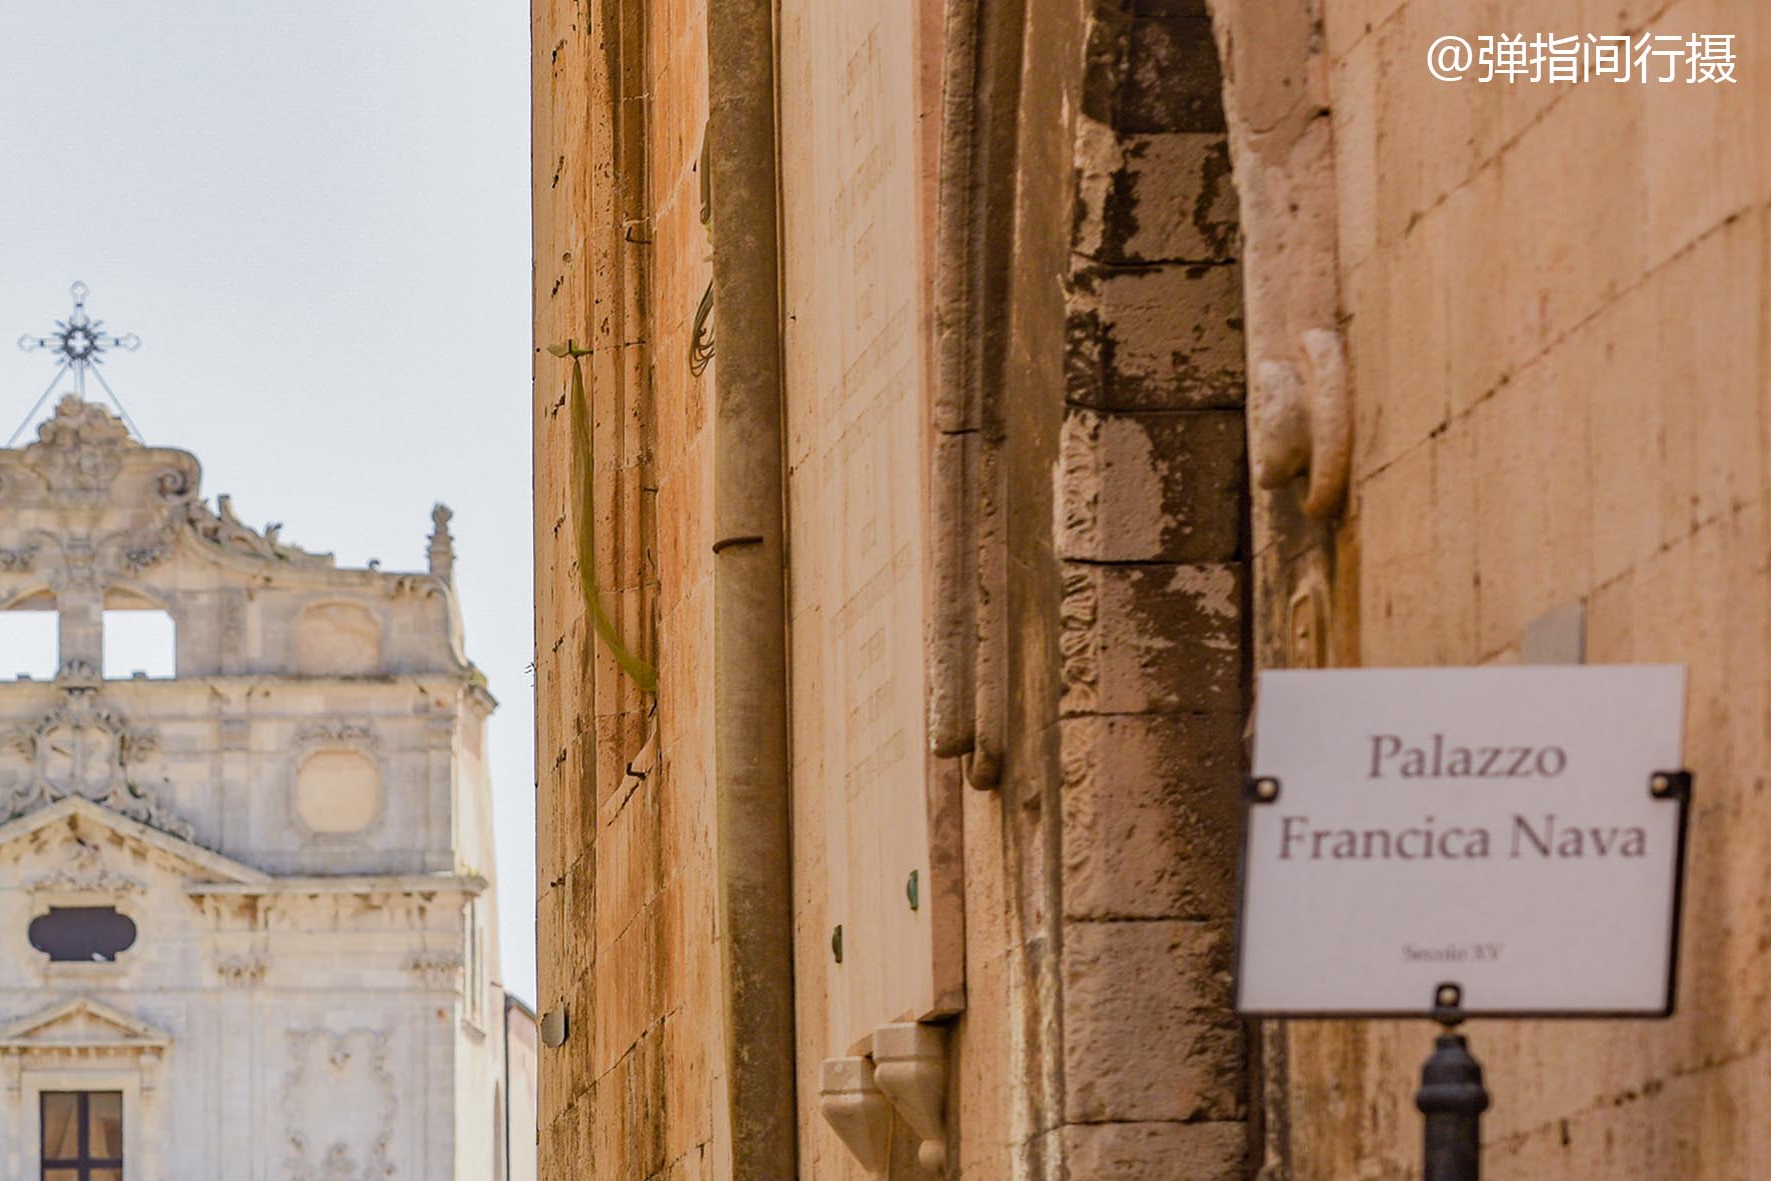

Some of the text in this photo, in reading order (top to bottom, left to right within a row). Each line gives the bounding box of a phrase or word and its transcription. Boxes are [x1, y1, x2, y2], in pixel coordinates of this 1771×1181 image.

[1366, 733, 1568, 780] Palazzo
[1278, 813, 1647, 861] Francica Nava
